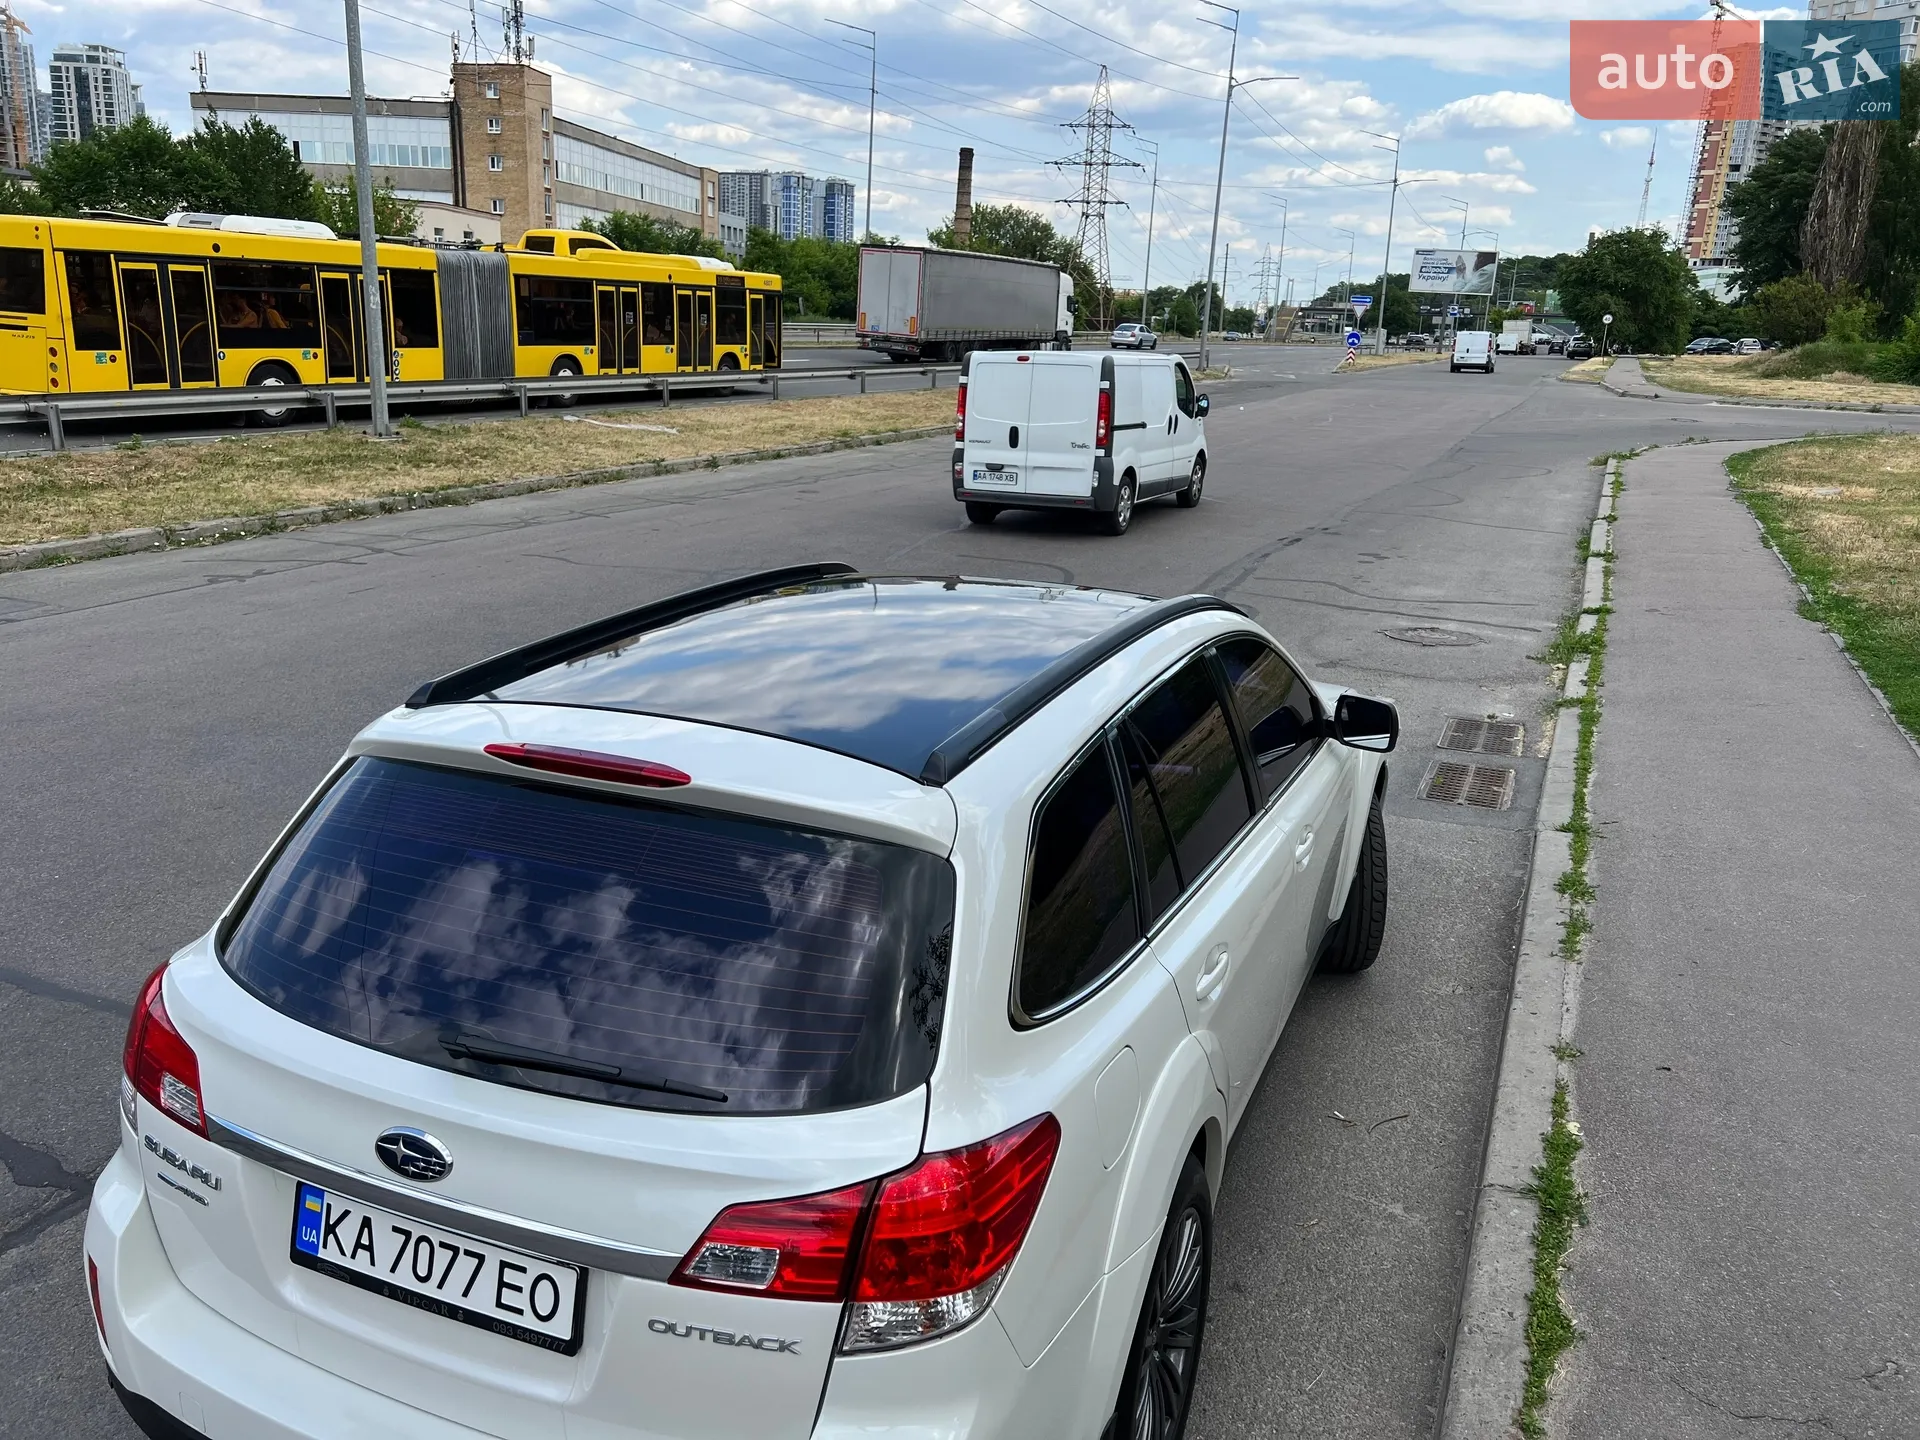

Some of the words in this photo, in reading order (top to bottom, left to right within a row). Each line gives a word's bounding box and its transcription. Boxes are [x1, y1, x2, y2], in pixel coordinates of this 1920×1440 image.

[977, 472, 987, 480] AA
[988, 473, 1004, 481] 1748
[1005, 474, 1015, 482] XB
[144, 1133, 222, 1192] SUBARU
[302, 1226, 318, 1245] UA
[321, 1202, 377, 1268] KA
[389, 1224, 486, 1298] 7077
[495, 1259, 560, 1322] EO
[492, 1321, 514, 1336] 093
[516, 1329, 566, 1352] 5497777
[648, 1315, 802, 1355] OUTBACK
